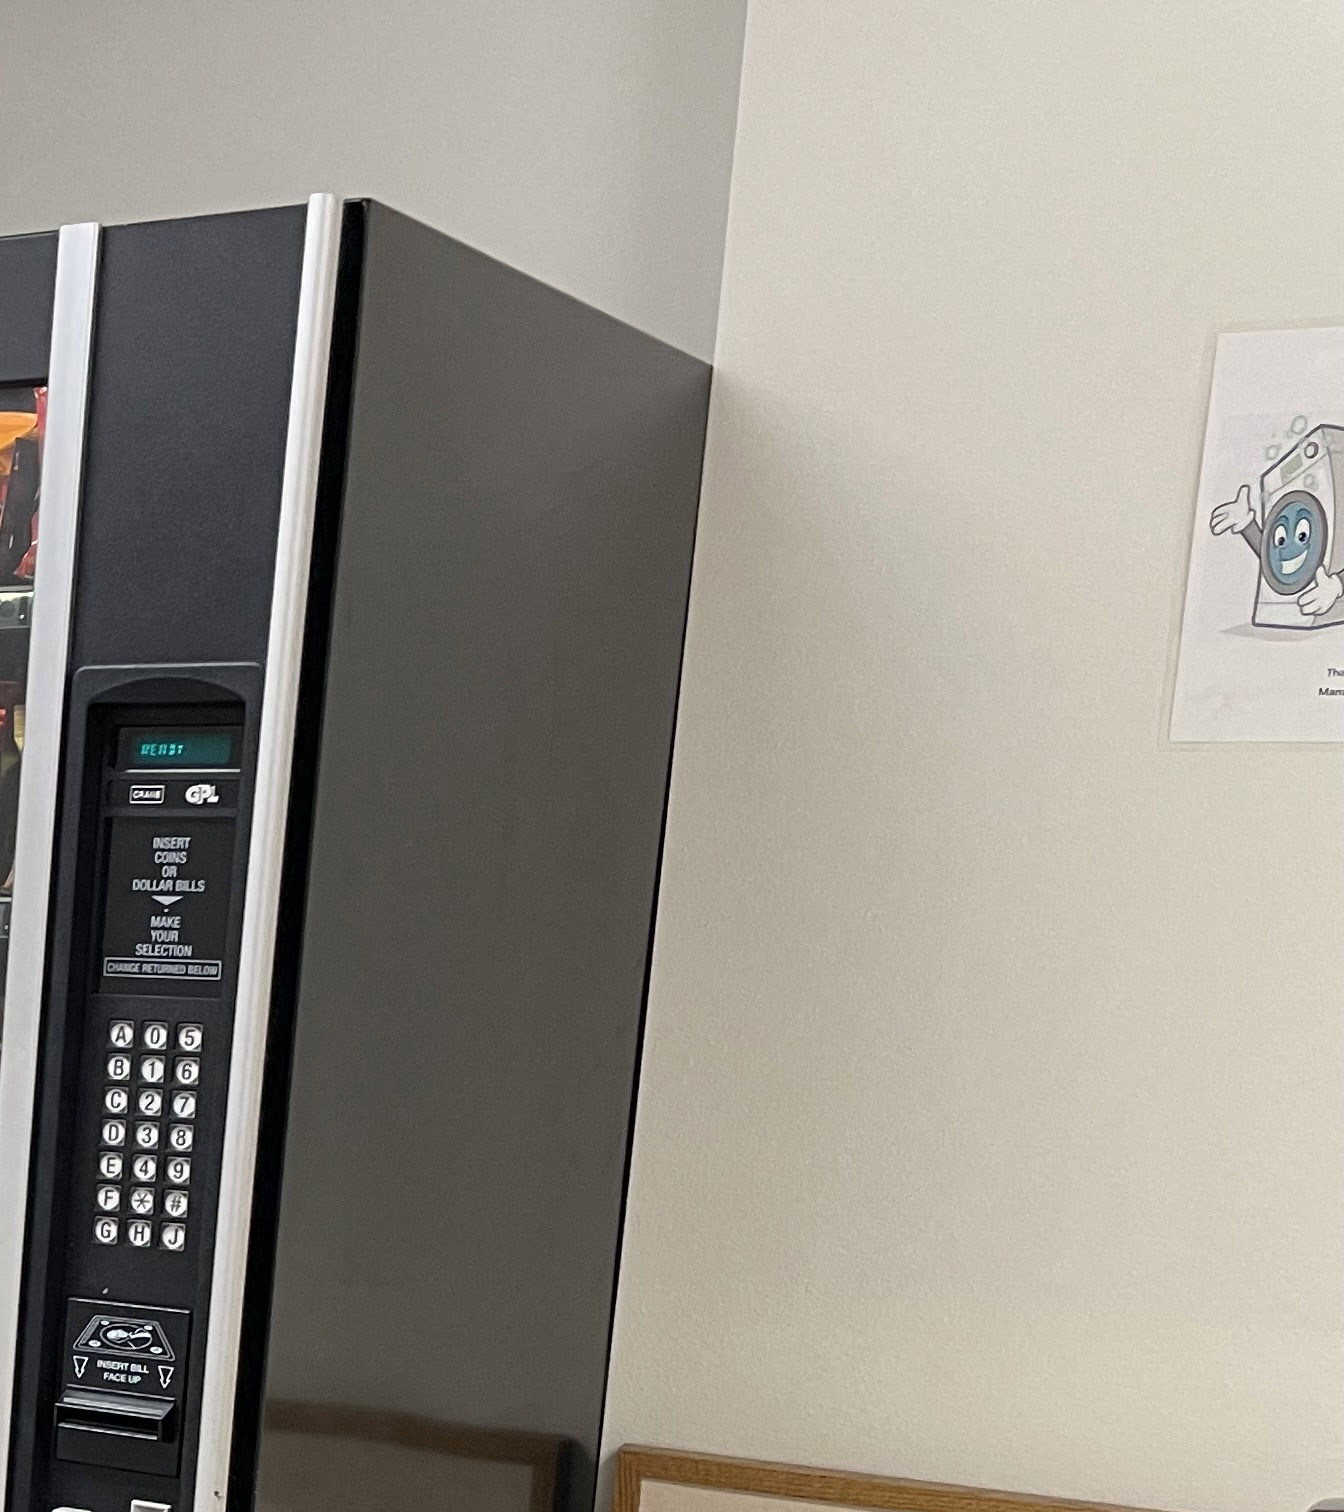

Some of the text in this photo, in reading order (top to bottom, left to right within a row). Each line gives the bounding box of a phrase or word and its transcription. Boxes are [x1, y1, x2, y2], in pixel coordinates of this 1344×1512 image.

[133, 784, 219, 803] CRANE GPL
[153, 837, 191, 850] INSERT
[154, 851, 187, 865] COINS
[162, 866, 177, 878] OR
[132, 879, 206, 892] DOLLAR BILLS
[150, 916, 181, 929] MAKE
[150, 930, 179, 943] YOUR
[135, 943, 193, 957] SELECTION
[106, 962, 218, 976] CHANGE RETURNED BELOW
[115, 1026, 195, 1047] A 0 5
[113, 1059, 192, 1080] B 1 6
[110, 1091, 190, 1114] C 2 7
[108, 1124, 186, 1146] D 3 8
[106, 1157, 184, 1180] E 4 9
[103, 1189, 182, 1213] F #
[100, 1221, 179, 1245] G H J
[97, 1360, 150, 1374] INSERT BILL
[103, 1372, 142, 1384] FACE UP
